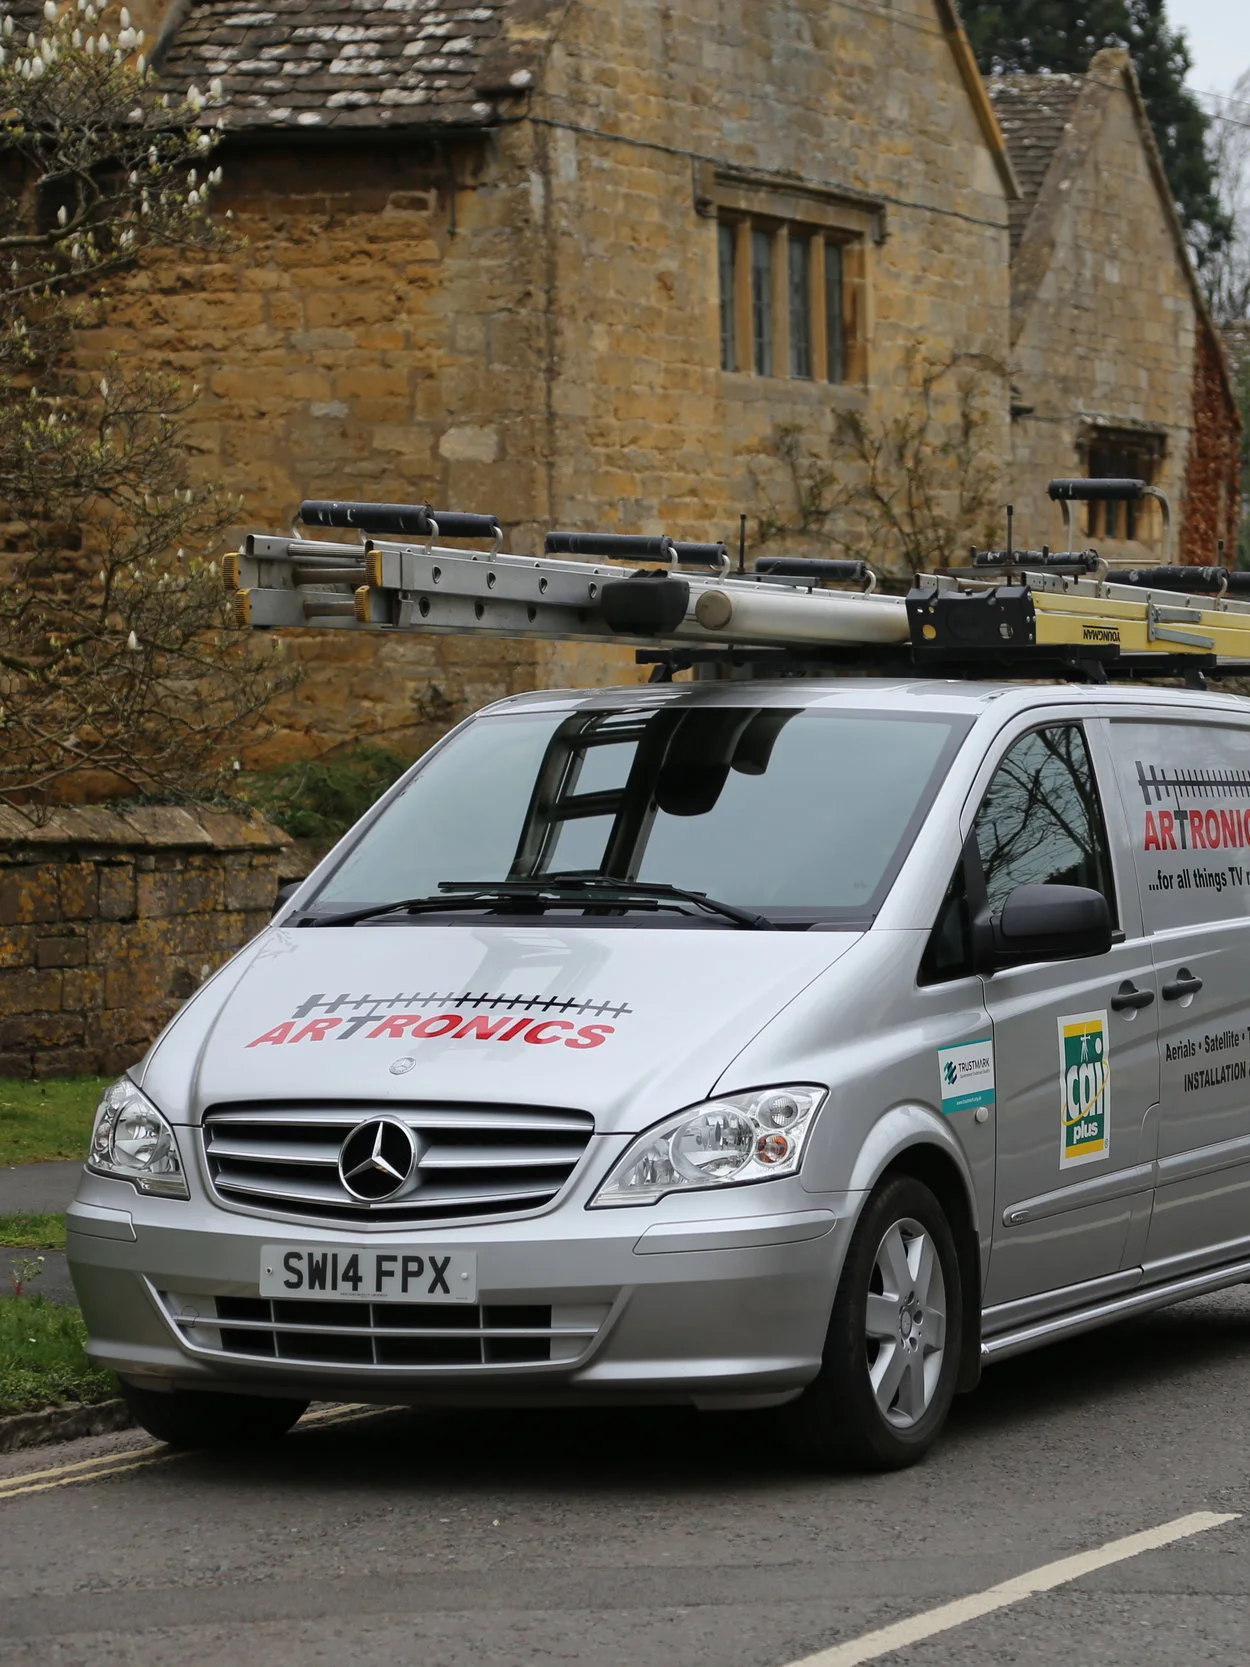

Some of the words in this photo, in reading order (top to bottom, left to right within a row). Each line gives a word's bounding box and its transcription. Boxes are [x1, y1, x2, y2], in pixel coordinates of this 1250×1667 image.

[1083, 629, 1120, 642] YOUNGMAN
[1148, 869, 1173, 891] ...for
[1177, 868, 1192, 889] all
[1193, 867, 1228, 892] things
[1228, 866, 1243, 886] TV
[245, 1014, 616, 1049] ARTRONICS
[1165, 1038, 1196, 1062] Aerials
[1204, 1030, 1240, 1054] Satellite
[958, 1057, 990, 1073] TRUSTMARK
[1066, 1037, 1104, 1120] cai
[1184, 1060, 1247, 1093] INSTALLATION
[1073, 1120, 1099, 1145] plus
[283, 1251, 363, 1292] SW14
[375, 1254, 452, 1295] FPX
